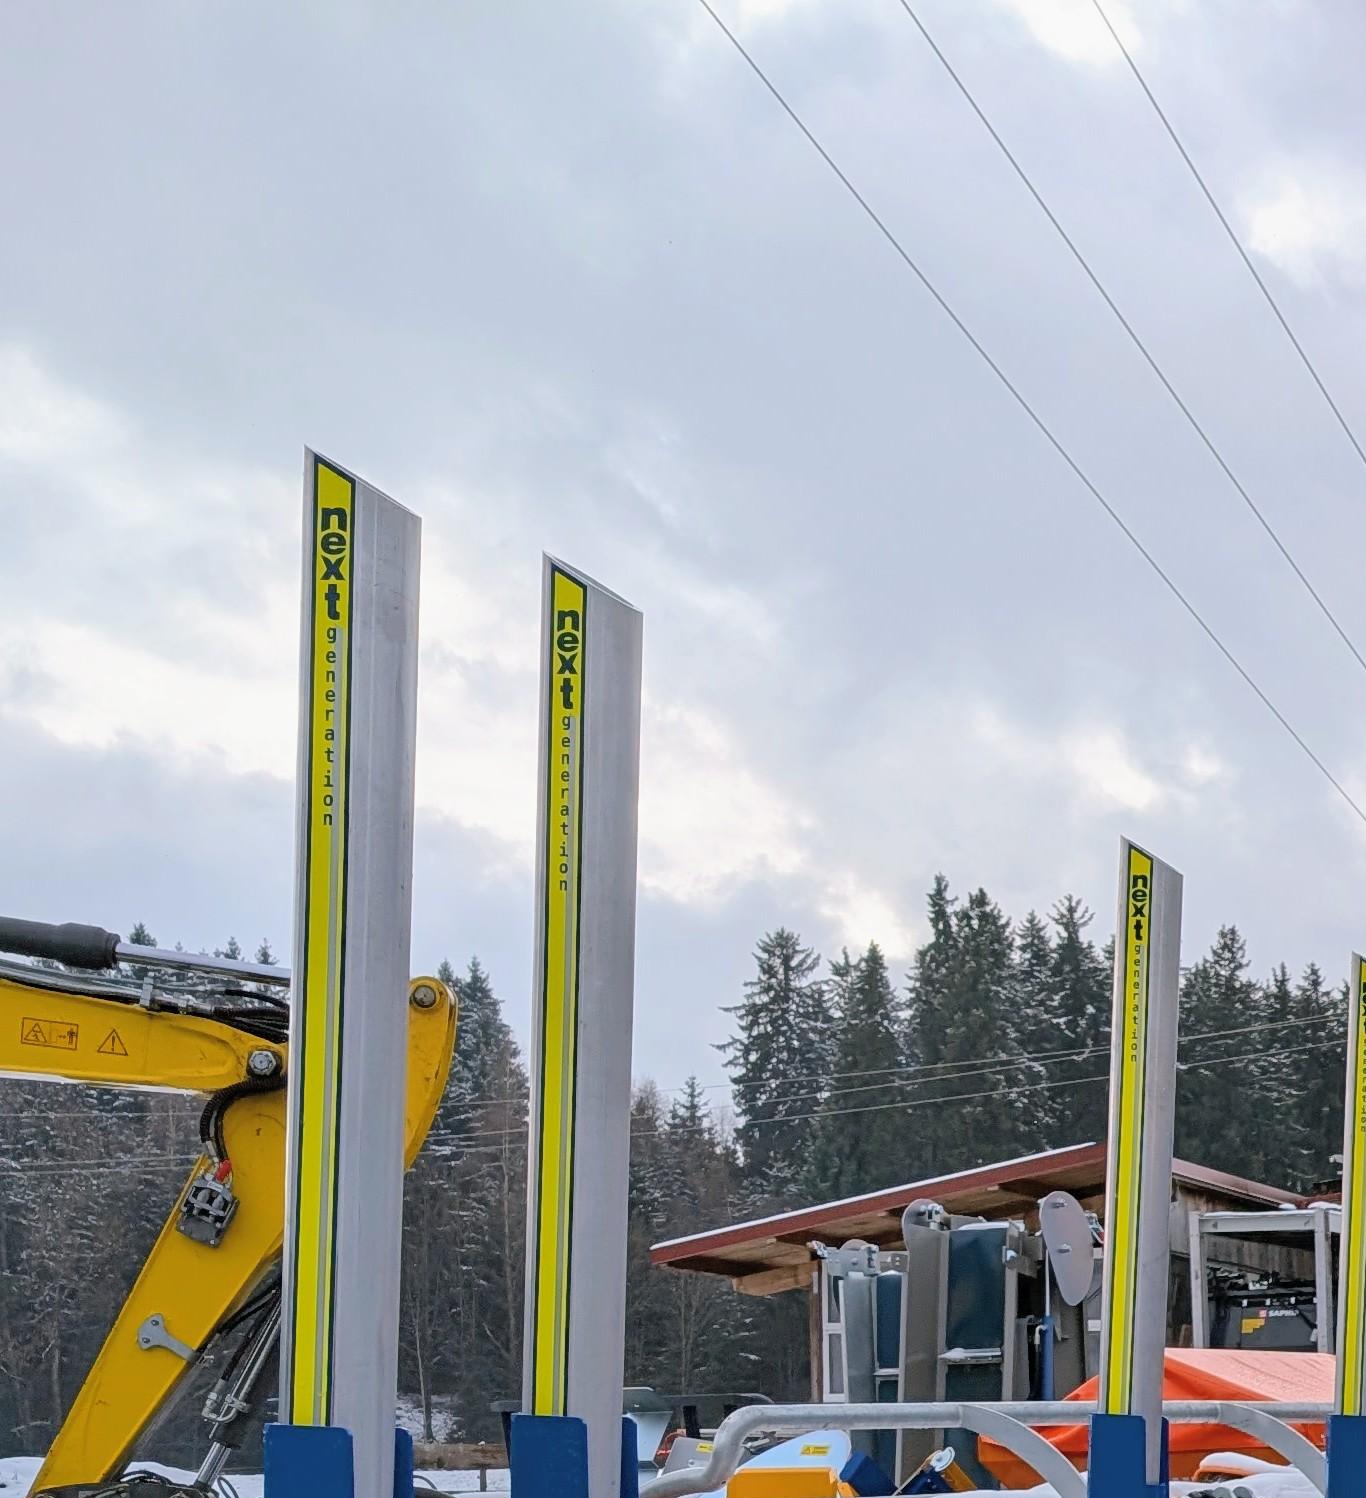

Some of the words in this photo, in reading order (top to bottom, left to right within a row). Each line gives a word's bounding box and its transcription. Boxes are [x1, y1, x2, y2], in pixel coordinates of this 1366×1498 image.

[320, 506, 348, 621] next
[556, 609, 580, 710] next
[323, 626, 337, 826] generation
[560, 715, 571, 892] generation
[1131, 874, 1148, 941] next
[1131, 944, 1141, 1062] generation
